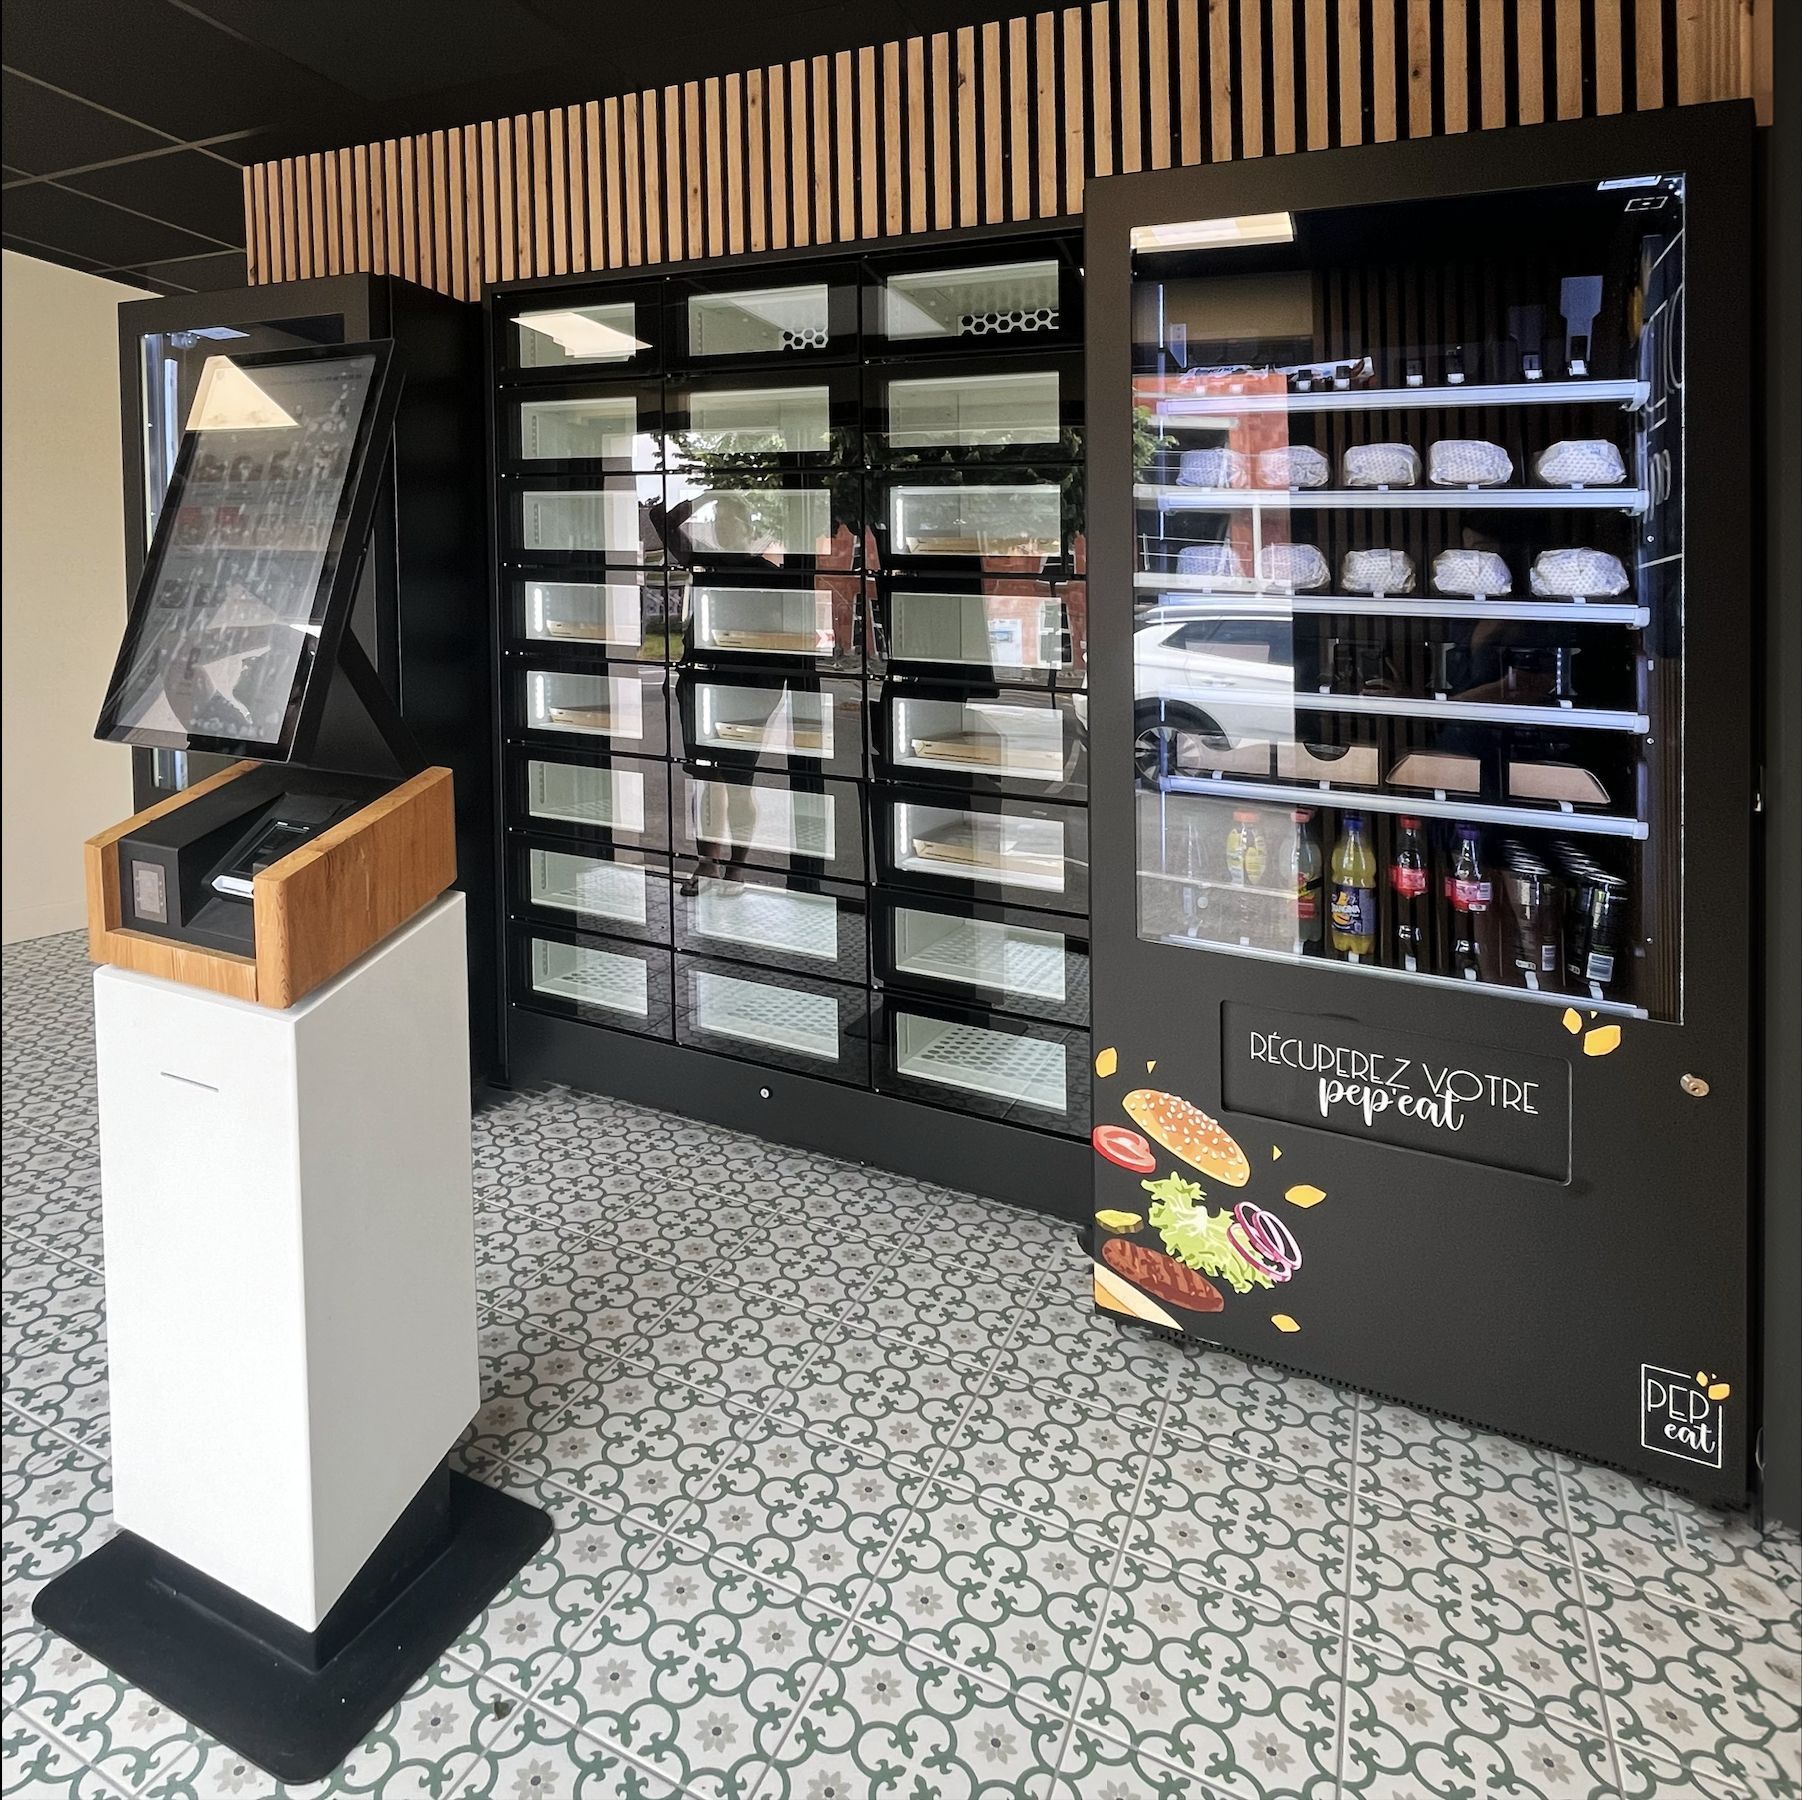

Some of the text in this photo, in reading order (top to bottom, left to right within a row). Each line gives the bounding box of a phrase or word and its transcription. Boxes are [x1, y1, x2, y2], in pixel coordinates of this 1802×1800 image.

[1250, 1031, 1540, 1115] RÉCUPEREZ VOTRE
[1318, 1076, 1465, 1131] pep'eat
[1647, 1378, 1710, 1424] PEP
[1663, 1422, 1716, 1454] eat
